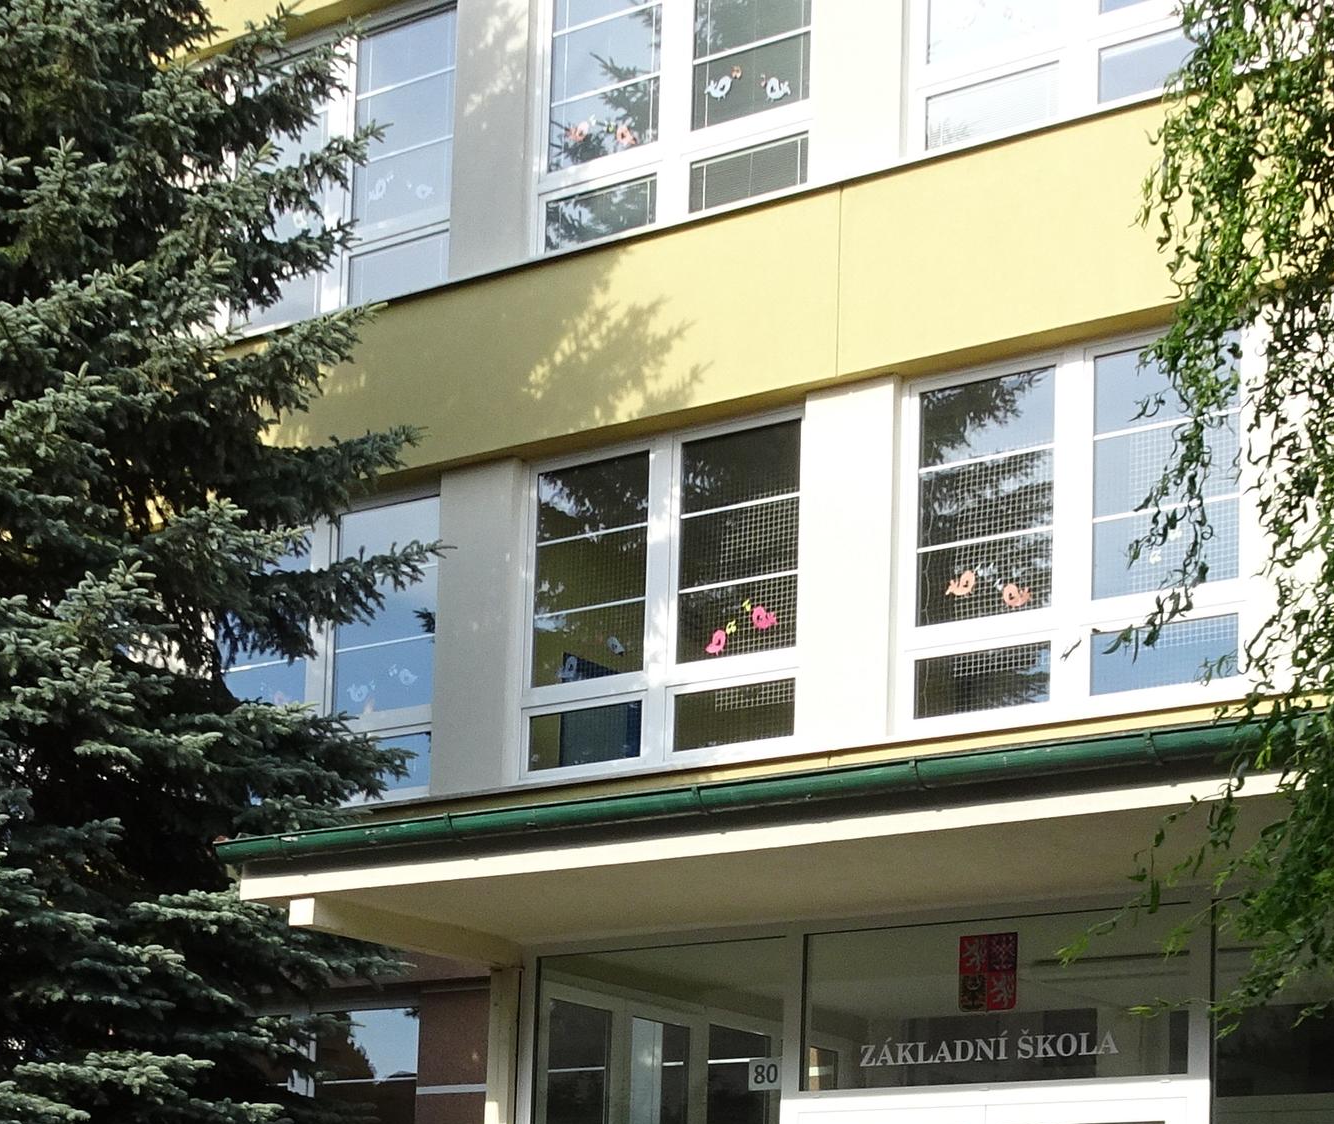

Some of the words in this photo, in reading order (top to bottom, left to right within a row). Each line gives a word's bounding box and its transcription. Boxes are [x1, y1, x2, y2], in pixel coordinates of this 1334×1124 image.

[859, 1030, 1009, 1067] ZÁKLADNÍ
[1017, 1029, 1119, 1060] ŠKOLA
[754, 1063, 778, 1085] 80
